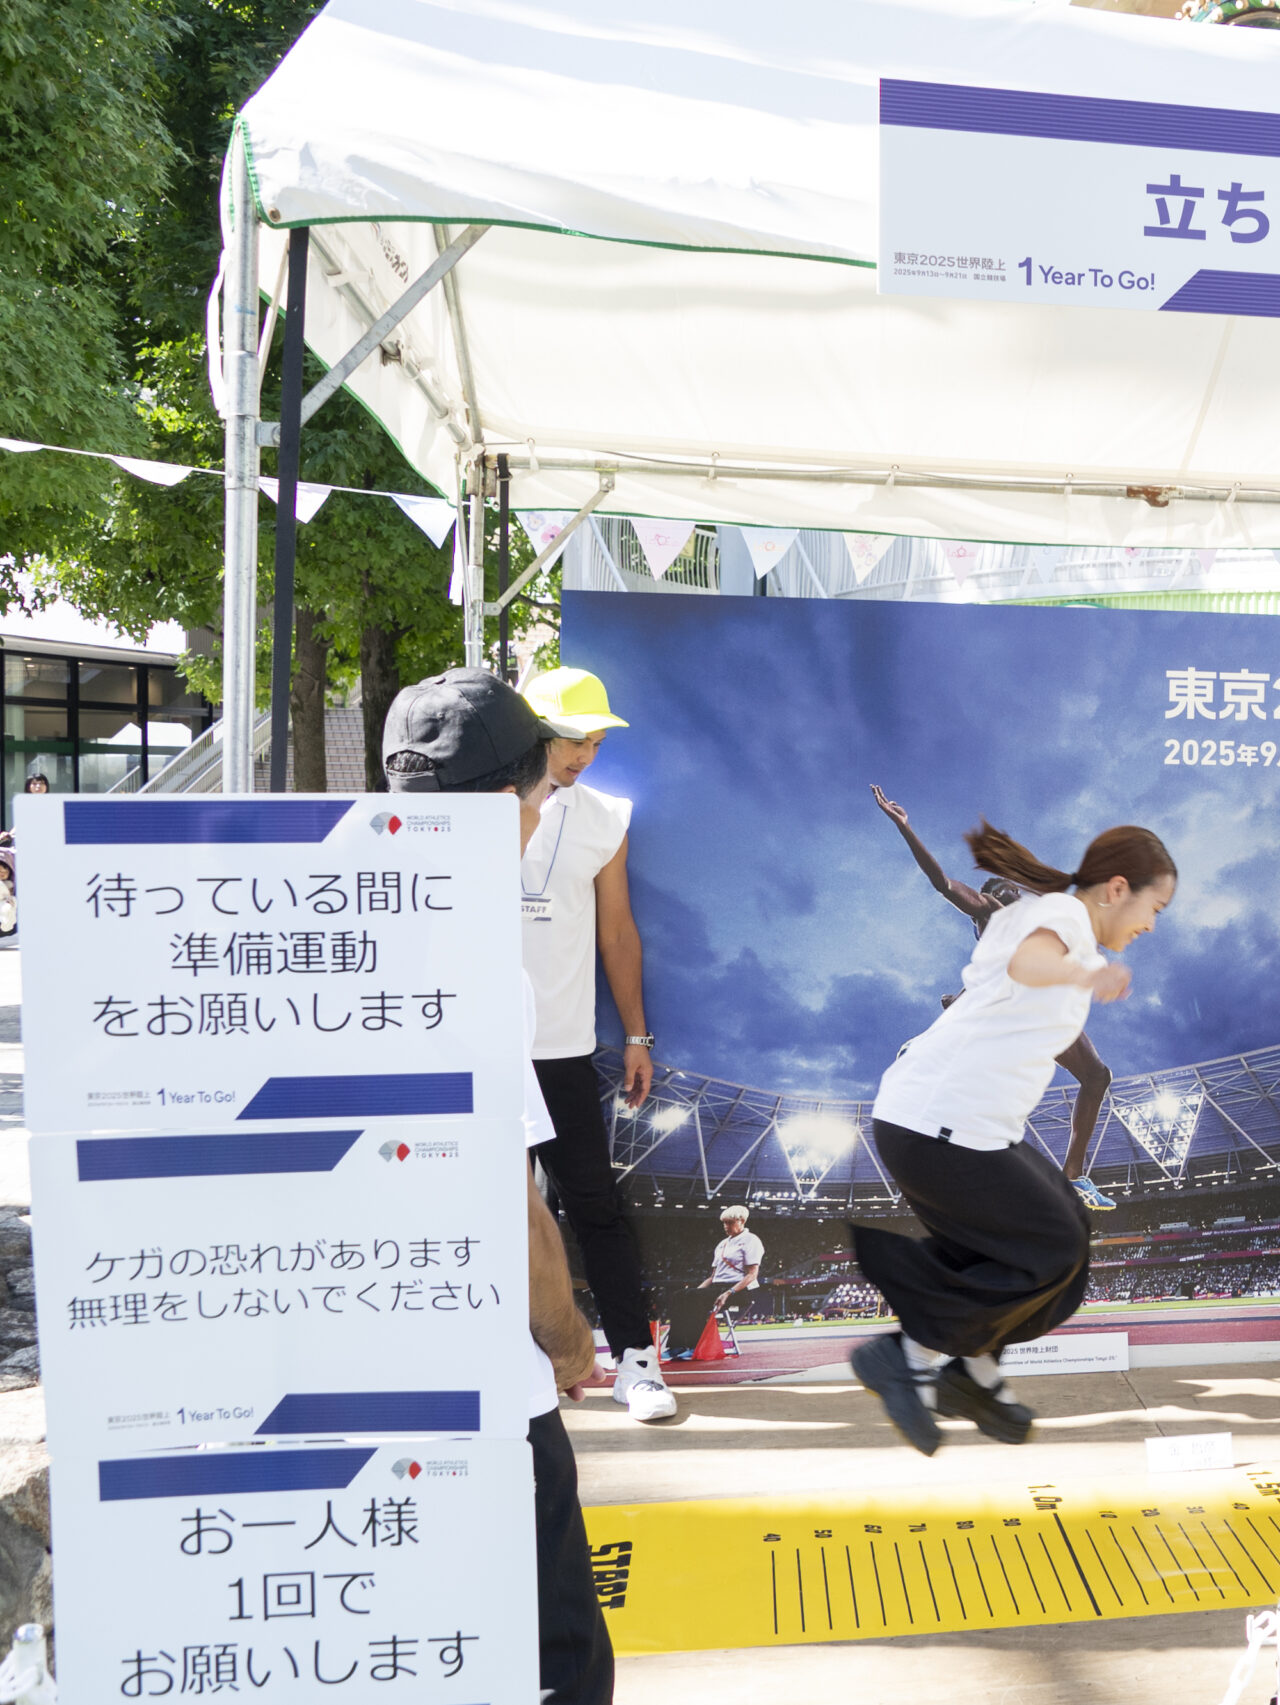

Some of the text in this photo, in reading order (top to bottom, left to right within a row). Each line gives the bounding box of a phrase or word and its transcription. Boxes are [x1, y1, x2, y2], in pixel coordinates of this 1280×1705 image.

[892, 252, 1006, 271] 東京2025世界陸上
[1018, 256, 1155, 291] 1 Year To Go!
[86, 871, 454, 918] 待っている間に
[169, 930, 378, 977] 準備運動
[92, 988, 458, 1037] をお願いします
[157, 1088, 165, 1106] 1
[169, 1092, 195, 1104] Year
[197, 1090, 212, 1104] To
[214, 1090, 236, 1104] Go!
[86, 1236, 481, 1284] ケガの恐れがあります
[67, 1279, 501, 1330] 無理をしないでください
[177, 1407, 185, 1425] 1
[188, 1410, 215, 1422] Year
[216, 1408, 231, 1420] To
[232, 1406, 254, 1419] Go!
[1099, 1510, 1118, 1518] 10
[1141, 1508, 1160, 1517] 20
[1232, 1502, 1250, 1510] 40
[178, 1496, 420, 1556] お一人様
[864, 1524, 882, 1534] 60
[908, 1523, 927, 1532] 70
[955, 1520, 975, 1529] 80
[1002, 1518, 1021, 1527] 90
[763, 1533, 781, 1542] 40
[814, 1529, 832, 1538] 50
[227, 1571, 377, 1622] 1回で
[120, 1630, 480, 1698] お願いします
